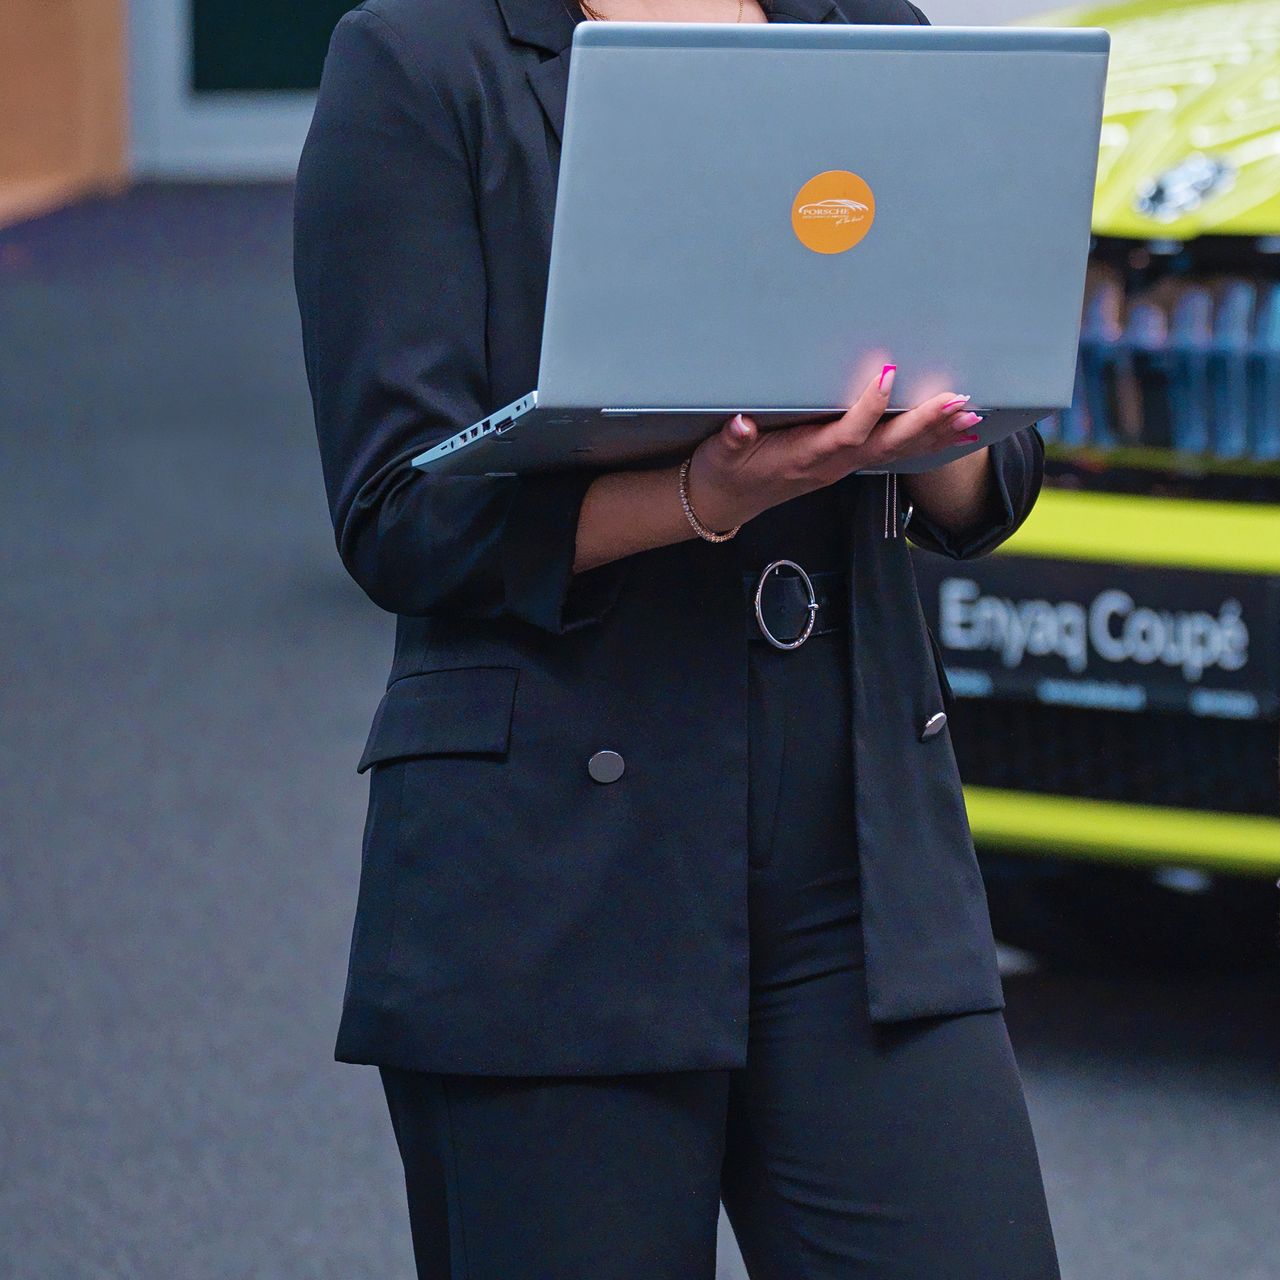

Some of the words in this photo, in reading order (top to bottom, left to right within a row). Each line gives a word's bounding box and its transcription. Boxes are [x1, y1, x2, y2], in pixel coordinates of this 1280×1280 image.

[803, 208, 849, 216] PORSCHE
[939, 578, 1089, 673] Enyaq
[1089, 589, 1249, 681] Coupé
